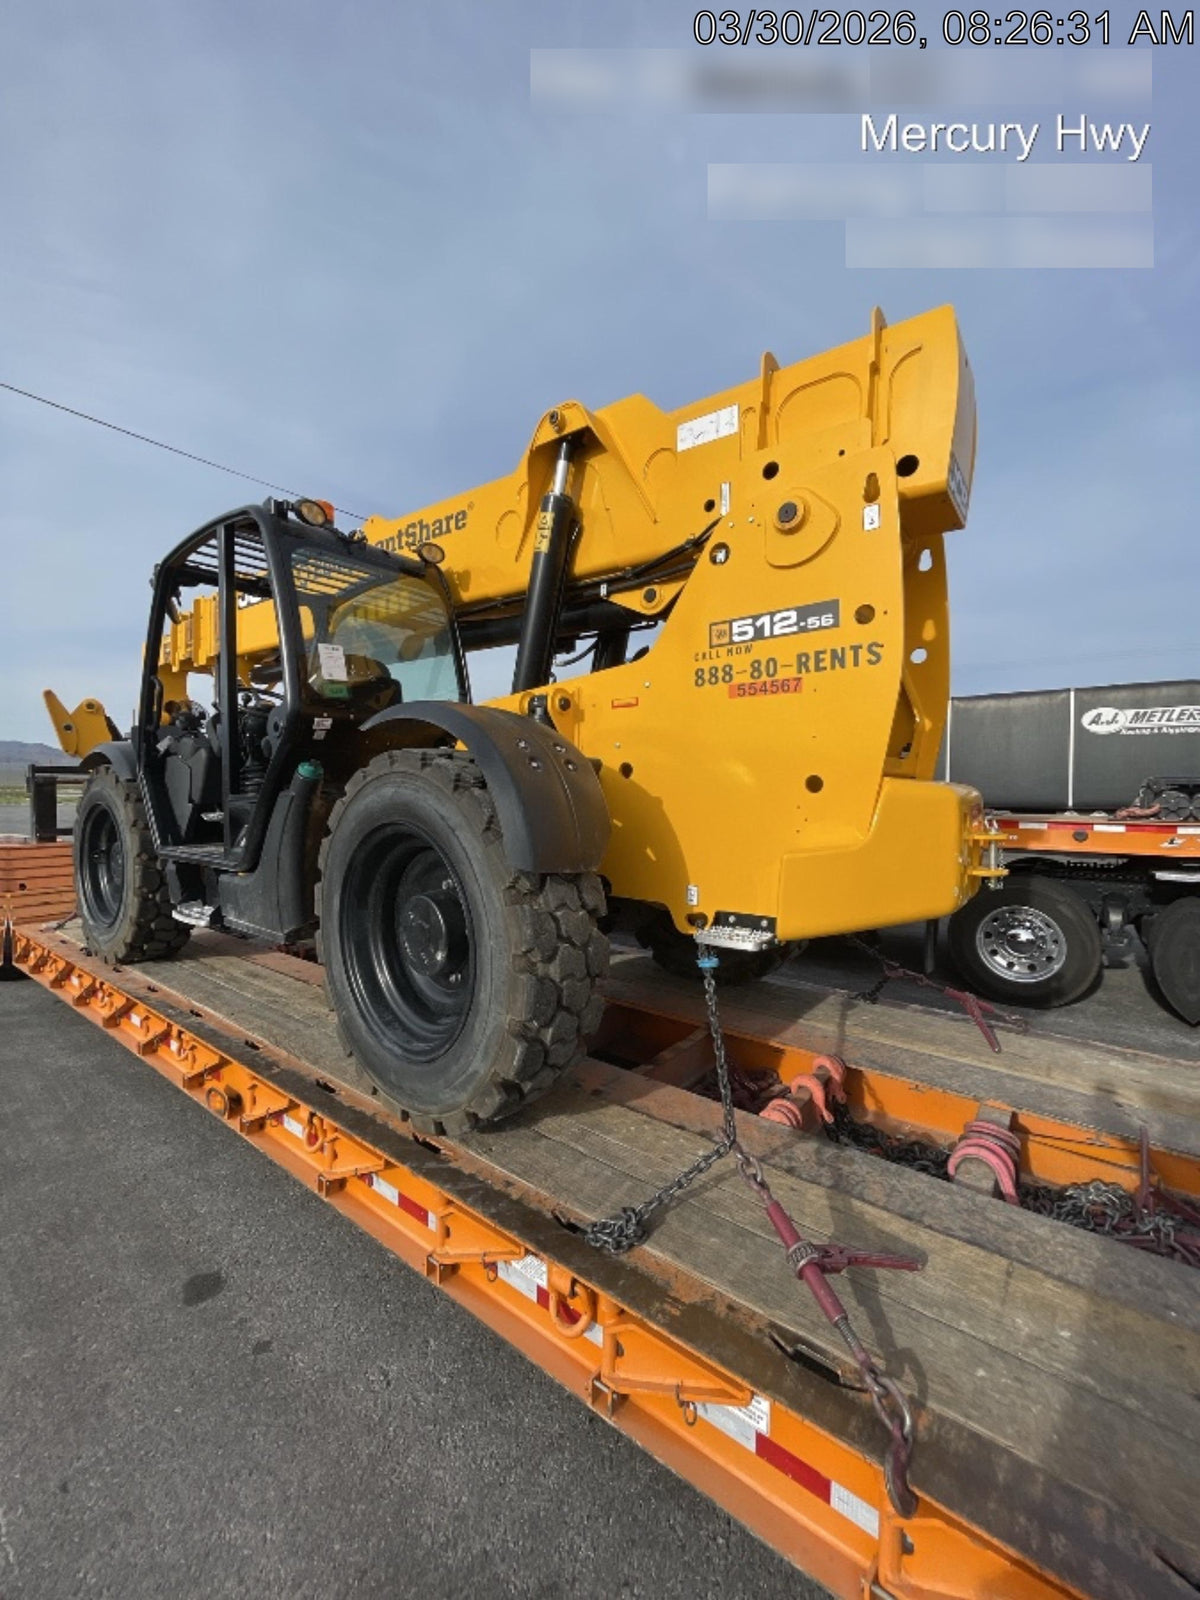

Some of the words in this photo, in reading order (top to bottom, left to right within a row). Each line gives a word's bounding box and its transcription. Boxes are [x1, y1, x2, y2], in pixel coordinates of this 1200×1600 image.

[731, 609, 835, 643] 512-56
[694, 650, 721, 662] CALL
[727, 644, 753, 657] NOW
[694, 641, 884, 687] 888-80-RENTS
[737, 677, 803, 697] 554567
